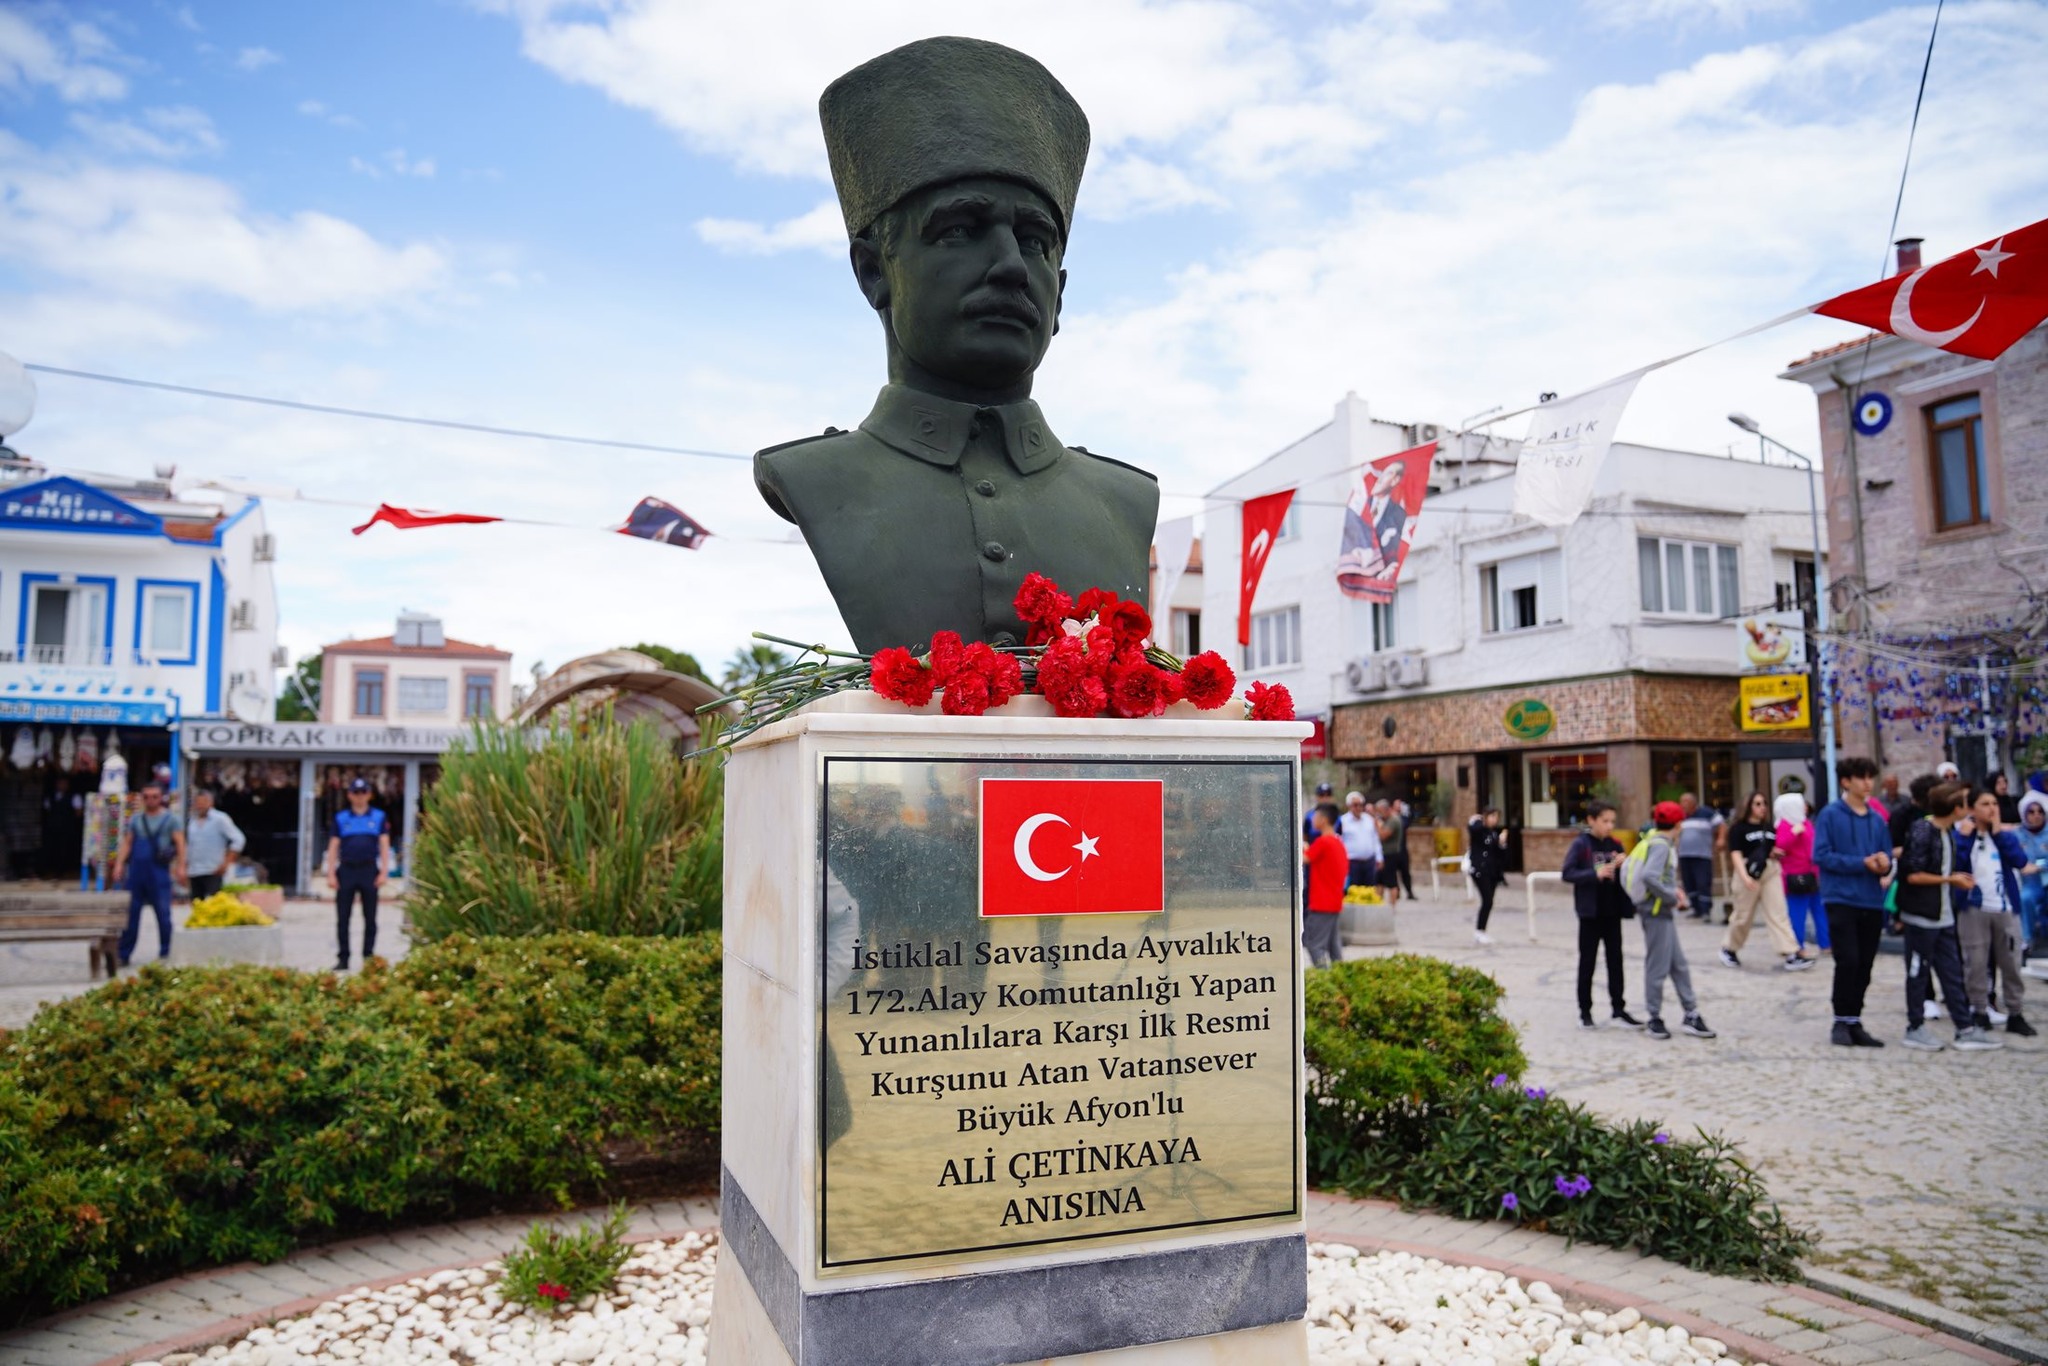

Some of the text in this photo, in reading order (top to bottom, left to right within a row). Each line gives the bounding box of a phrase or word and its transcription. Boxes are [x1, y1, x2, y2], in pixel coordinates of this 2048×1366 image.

[190, 725, 325, 747] TOPRAK
[852, 930, 1272, 970] İstiklal Savaşında Ayvalık'ta
[846, 971, 1276, 1016] 172.Alay Komutanlığı Yapan
[854, 1007, 1271, 1056] Yunanlılara Karşı İlk Resmi
[871, 1052, 1257, 1100] Kurşunu Atan Vatansever
[957, 1090, 1184, 1136] Büyük Afyon'lu
[937, 1136, 1202, 1189] ALİ ÇETİNKAYA
[999, 1186, 1146, 1227] ANISINA
